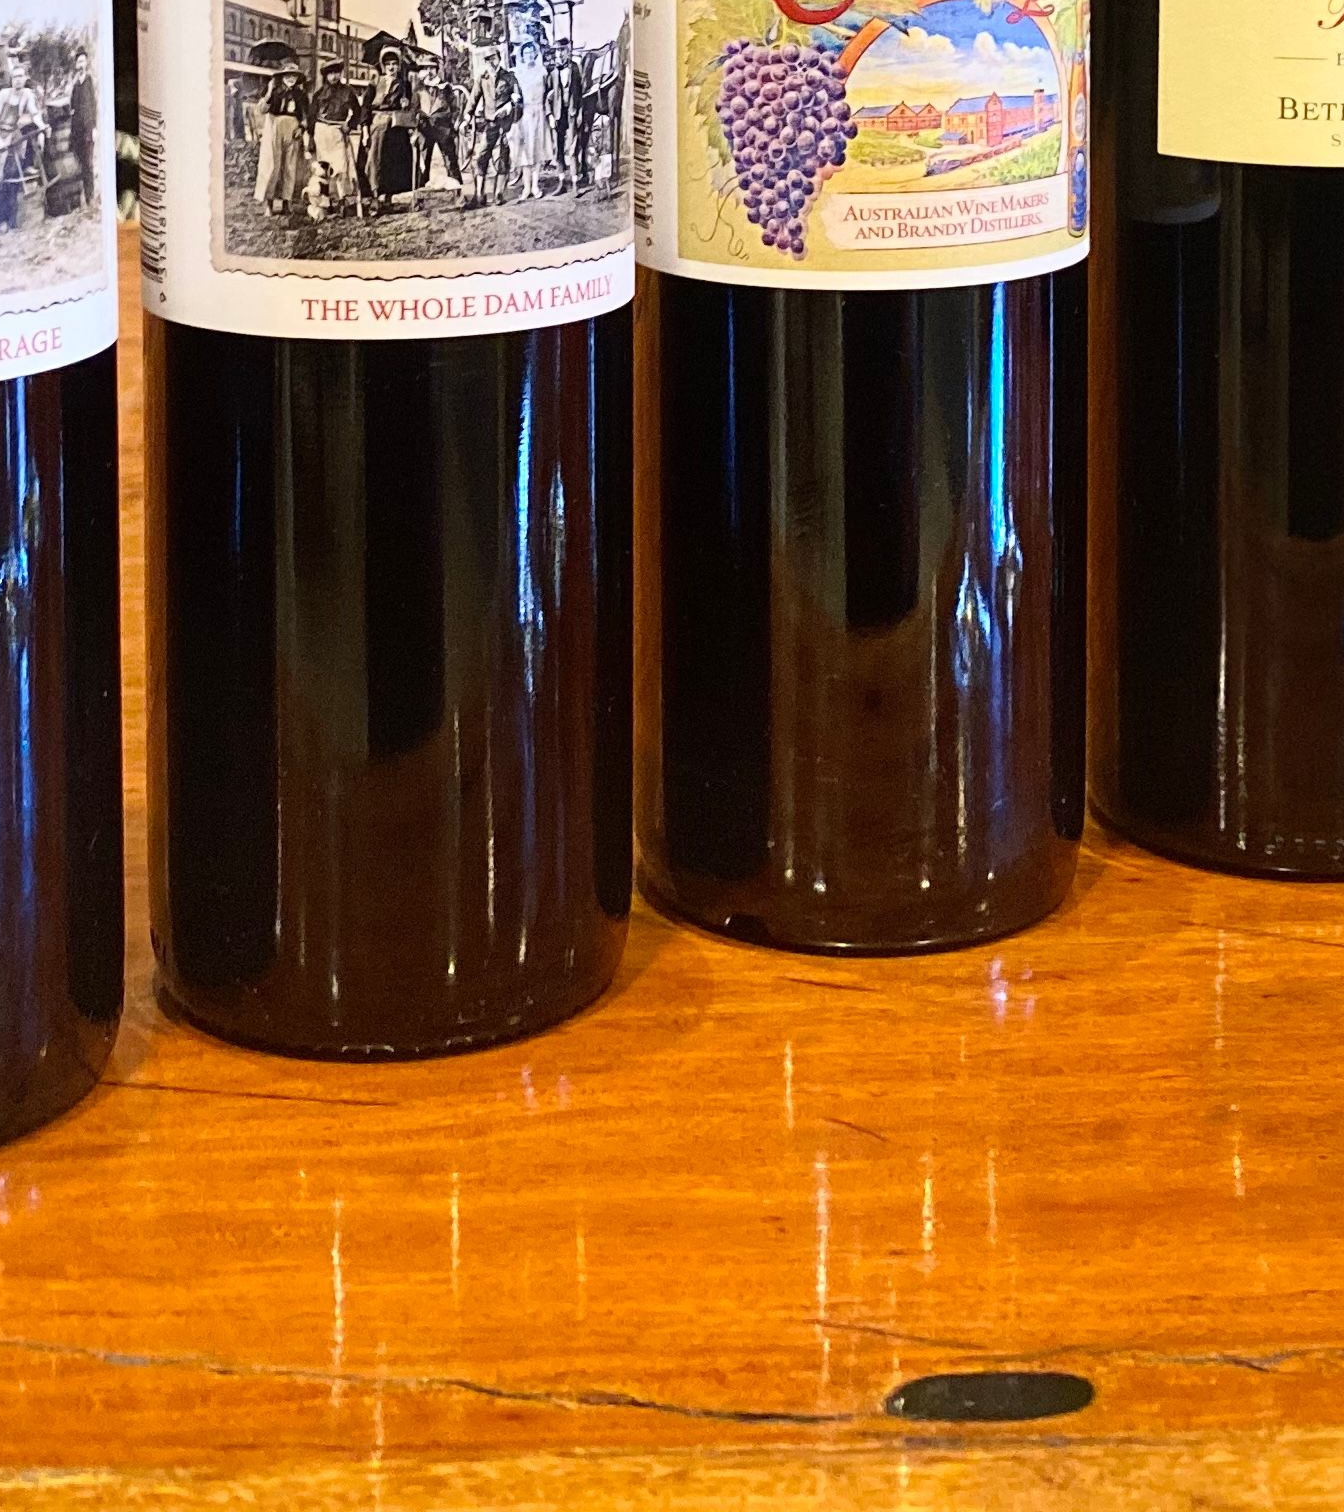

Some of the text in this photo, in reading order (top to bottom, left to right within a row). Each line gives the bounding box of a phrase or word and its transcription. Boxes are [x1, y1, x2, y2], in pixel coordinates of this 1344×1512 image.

[842, 191, 1050, 223] AUSTRALIAN WINE MAKERS
[855, 225, 894, 240] AND
[897, 221, 968, 240] BRANDY
[301, 275, 613, 323] THE WHOLE DAM FAMILY
